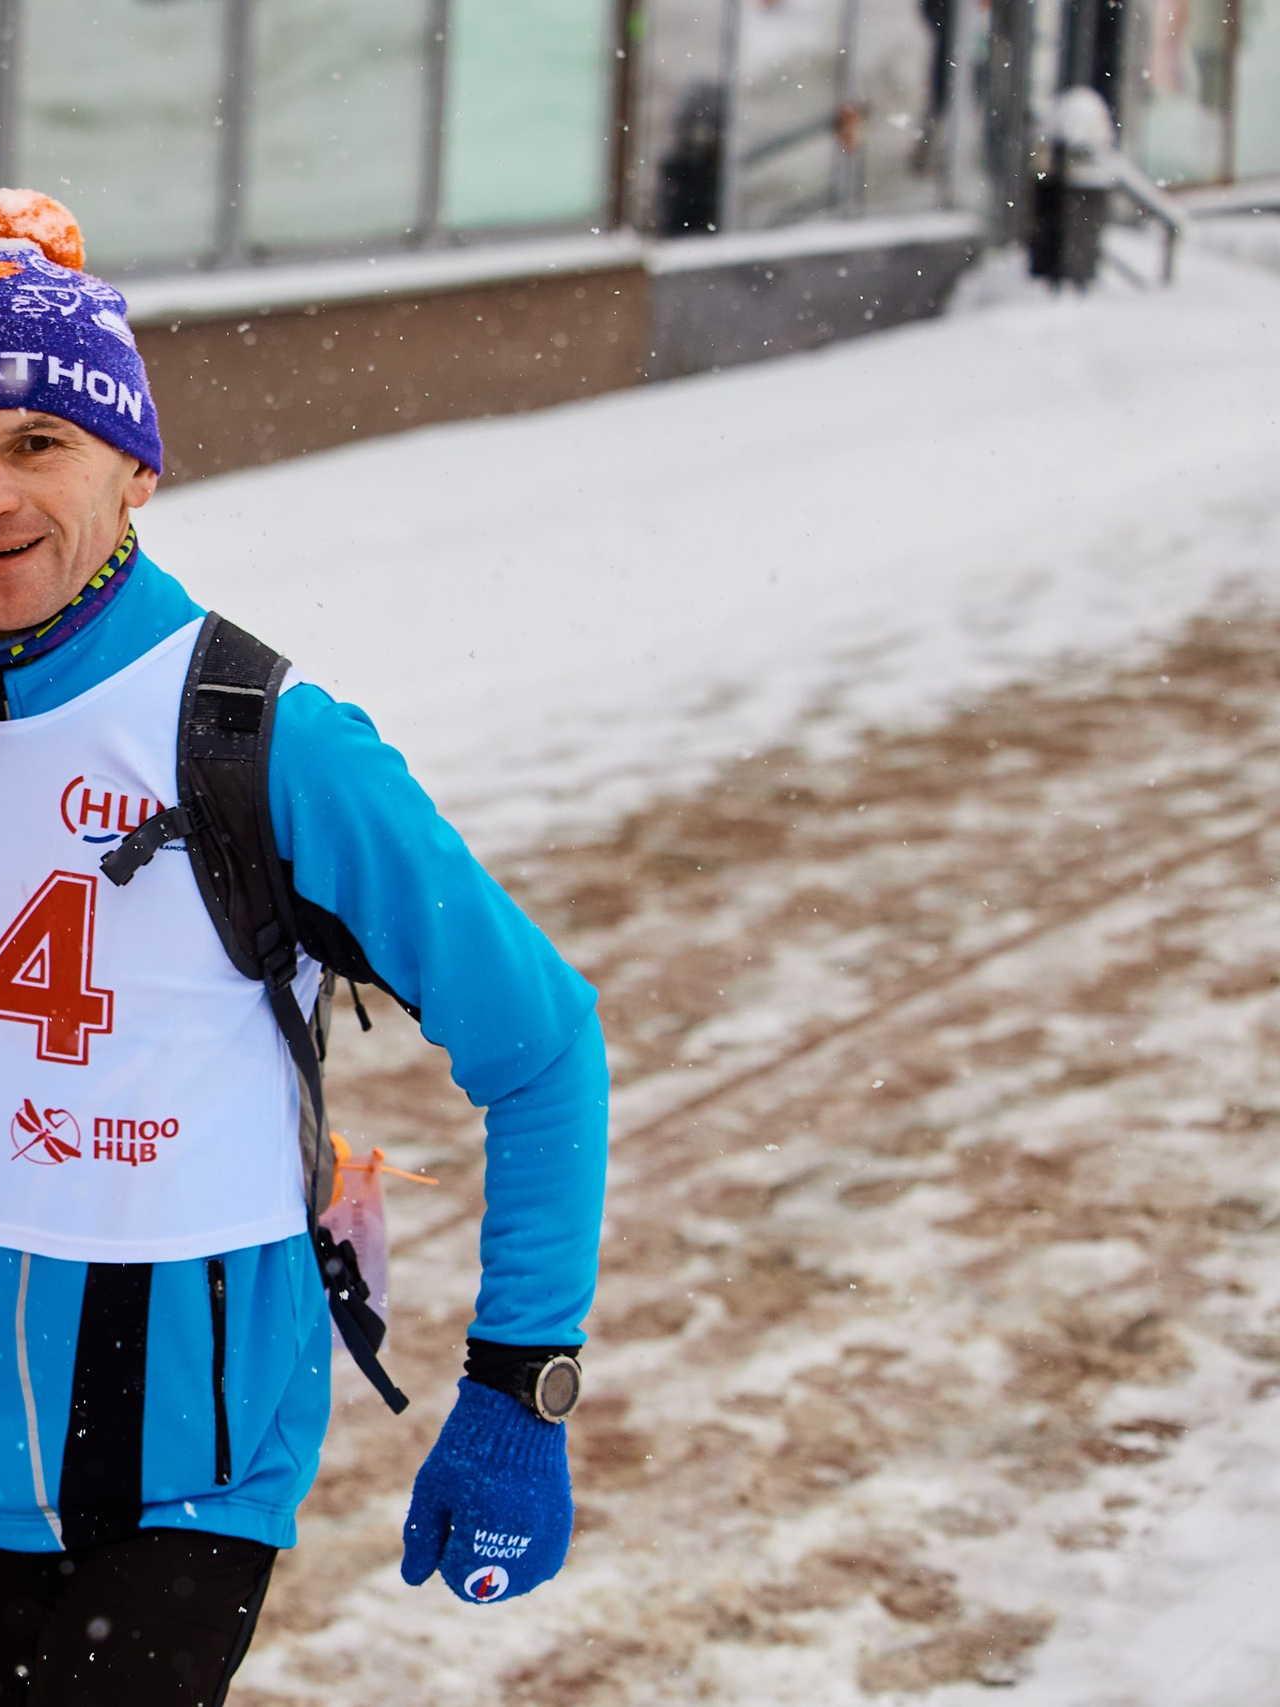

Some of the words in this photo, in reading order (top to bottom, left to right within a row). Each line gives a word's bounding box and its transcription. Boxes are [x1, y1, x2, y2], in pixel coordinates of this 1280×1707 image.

[79, 788, 166, 833] НЦ
[94, 1117, 179, 1140] ППОО
[93, 1140, 157, 1166] НЦВ
[473, 1542, 527, 1559] ДОРОГА
